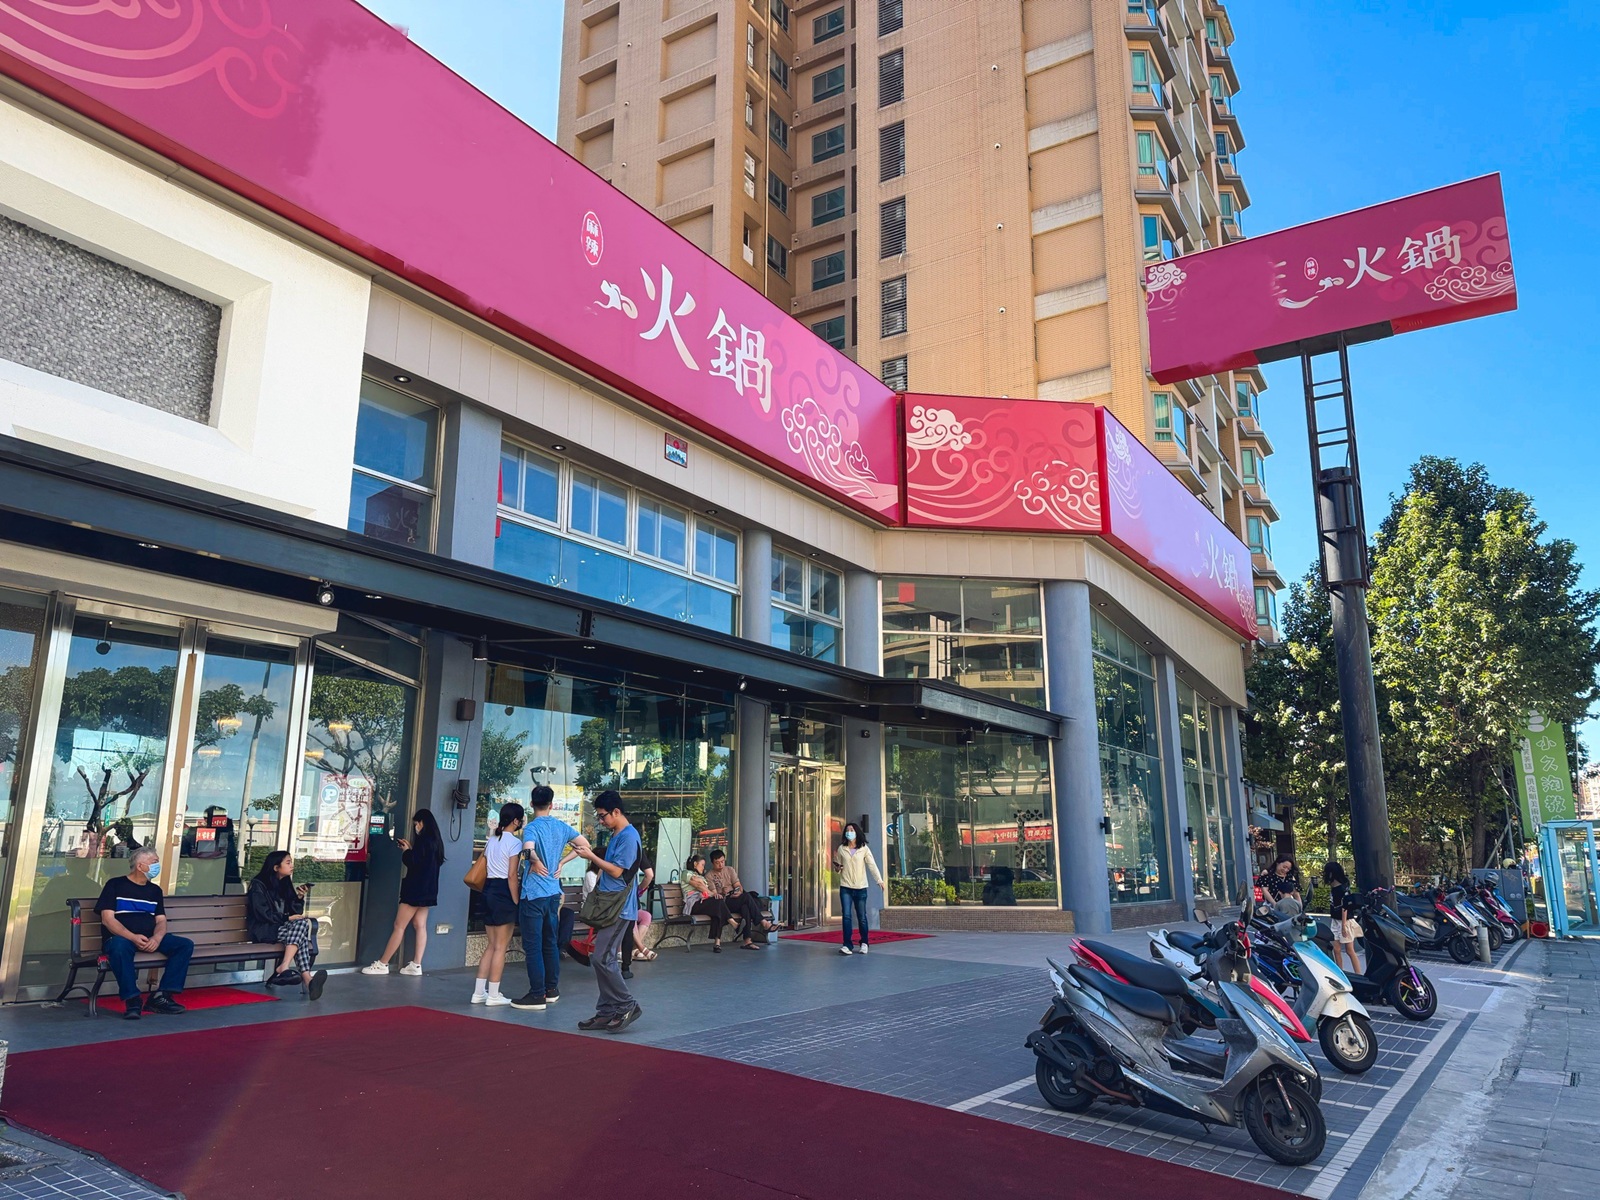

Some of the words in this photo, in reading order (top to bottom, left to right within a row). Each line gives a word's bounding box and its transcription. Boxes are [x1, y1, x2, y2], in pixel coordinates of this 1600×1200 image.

[586, 218, 599, 257] 麻辣
[1343, 226, 1461, 289] 火鍋
[639, 263, 773, 413] 火鍋
[1206, 533, 1241, 602] 火鍋
[443, 759, 457, 769] 159
[445, 742, 458, 752] 157
